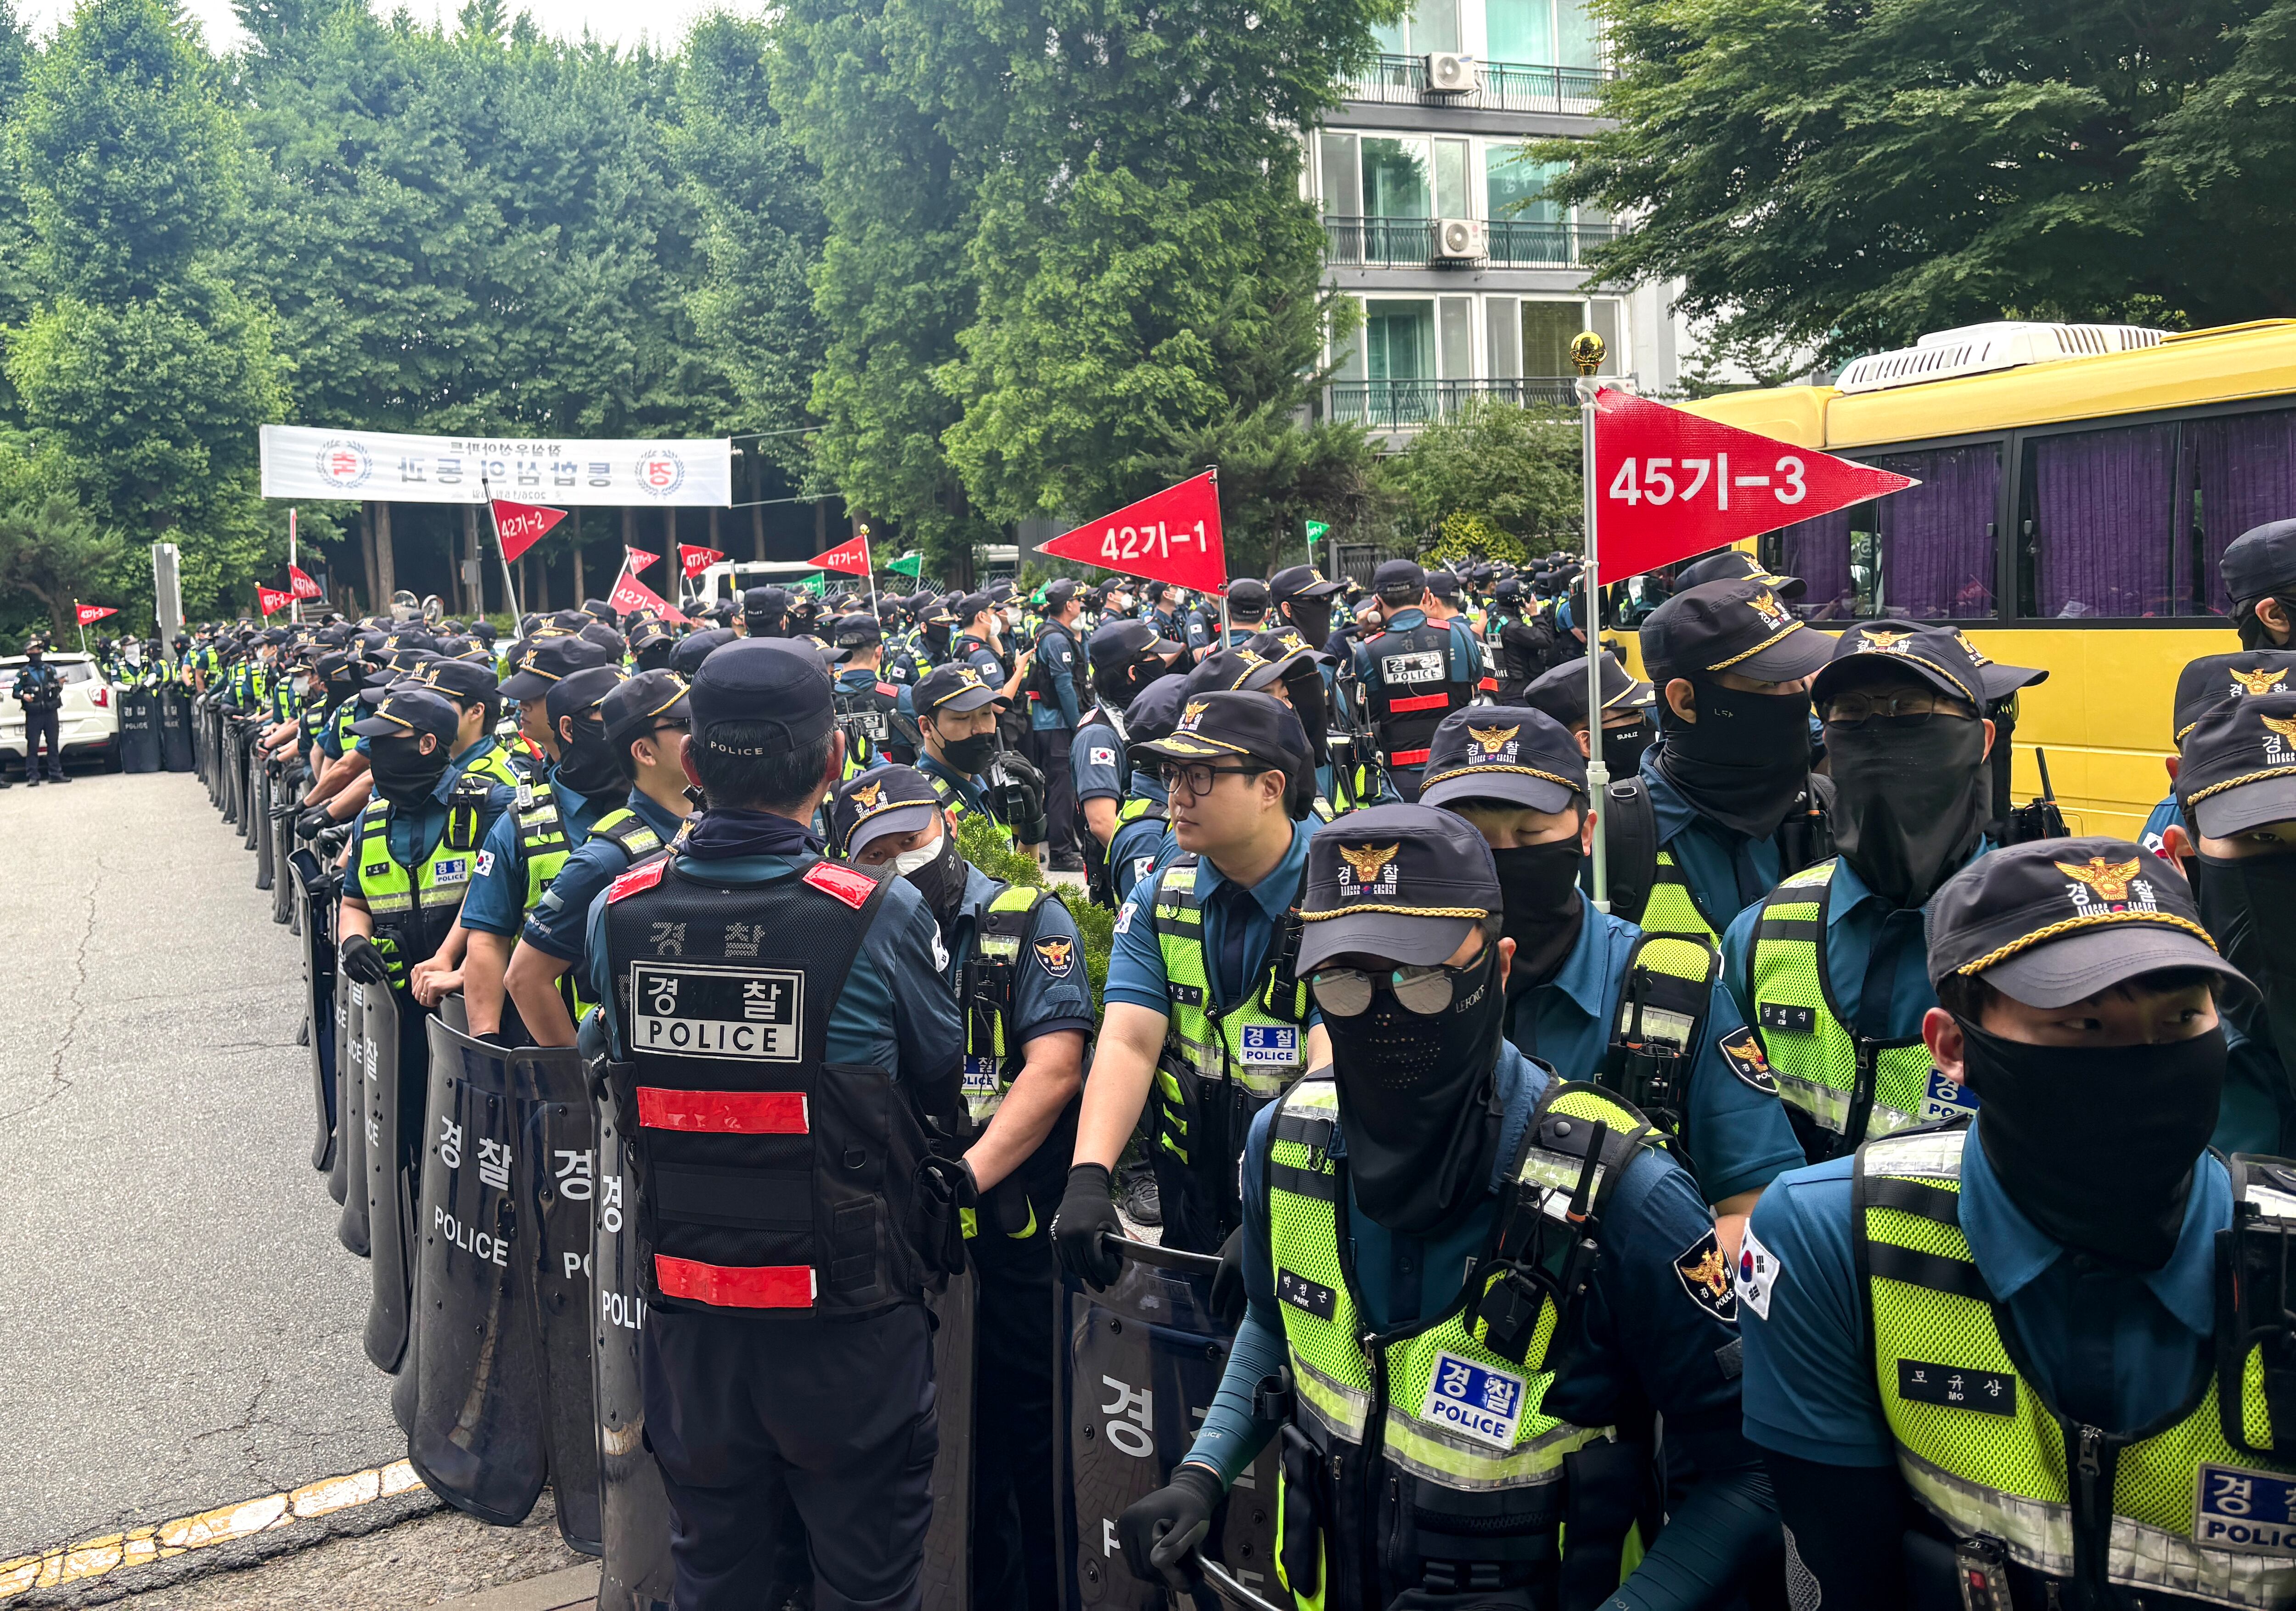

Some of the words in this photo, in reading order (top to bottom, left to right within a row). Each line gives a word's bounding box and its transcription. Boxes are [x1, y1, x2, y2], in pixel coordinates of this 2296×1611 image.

[1609, 452, 1806, 510] 45기-3
[501, 512, 545, 539] 42기-2
[1101, 519, 1207, 560] 42기-1
[827, 550, 864, 566] 47기-1
[616, 588, 665, 616] 42기-3
[1393, 668, 1436, 682] POLICE
[710, 740, 764, 756] POLICE
[438, 873, 464, 882] POLICE
[1337, 865, 1351, 886] 경
[1382, 864, 1399, 884] 찰
[2065, 882, 2090, 906] 경
[2132, 879, 2157, 903] 찰
[647, 976, 782, 1020] 경찰
[650, 1020, 777, 1053] POLICE
[1247, 1028, 1293, 1048] 경찰
[1246, 1051, 1293, 1060] POLICE
[439, 1115, 513, 1192] 경찰
[554, 1148, 592, 1200] 경
[602, 1174, 623, 1234] 경
[434, 1205, 509, 1267] POLICE
[1050, 1214, 1060, 1241] POLICE
[602, 1289, 647, 1330] POLI
[1293, 1294, 1310, 1308] PARK
[1715, 1288, 1734, 1310] POLICE
[1442, 1360, 1516, 1414] 경찰
[1948, 1391, 1964, 1401] MO
[1432, 1401, 1506, 1439] POLICE
